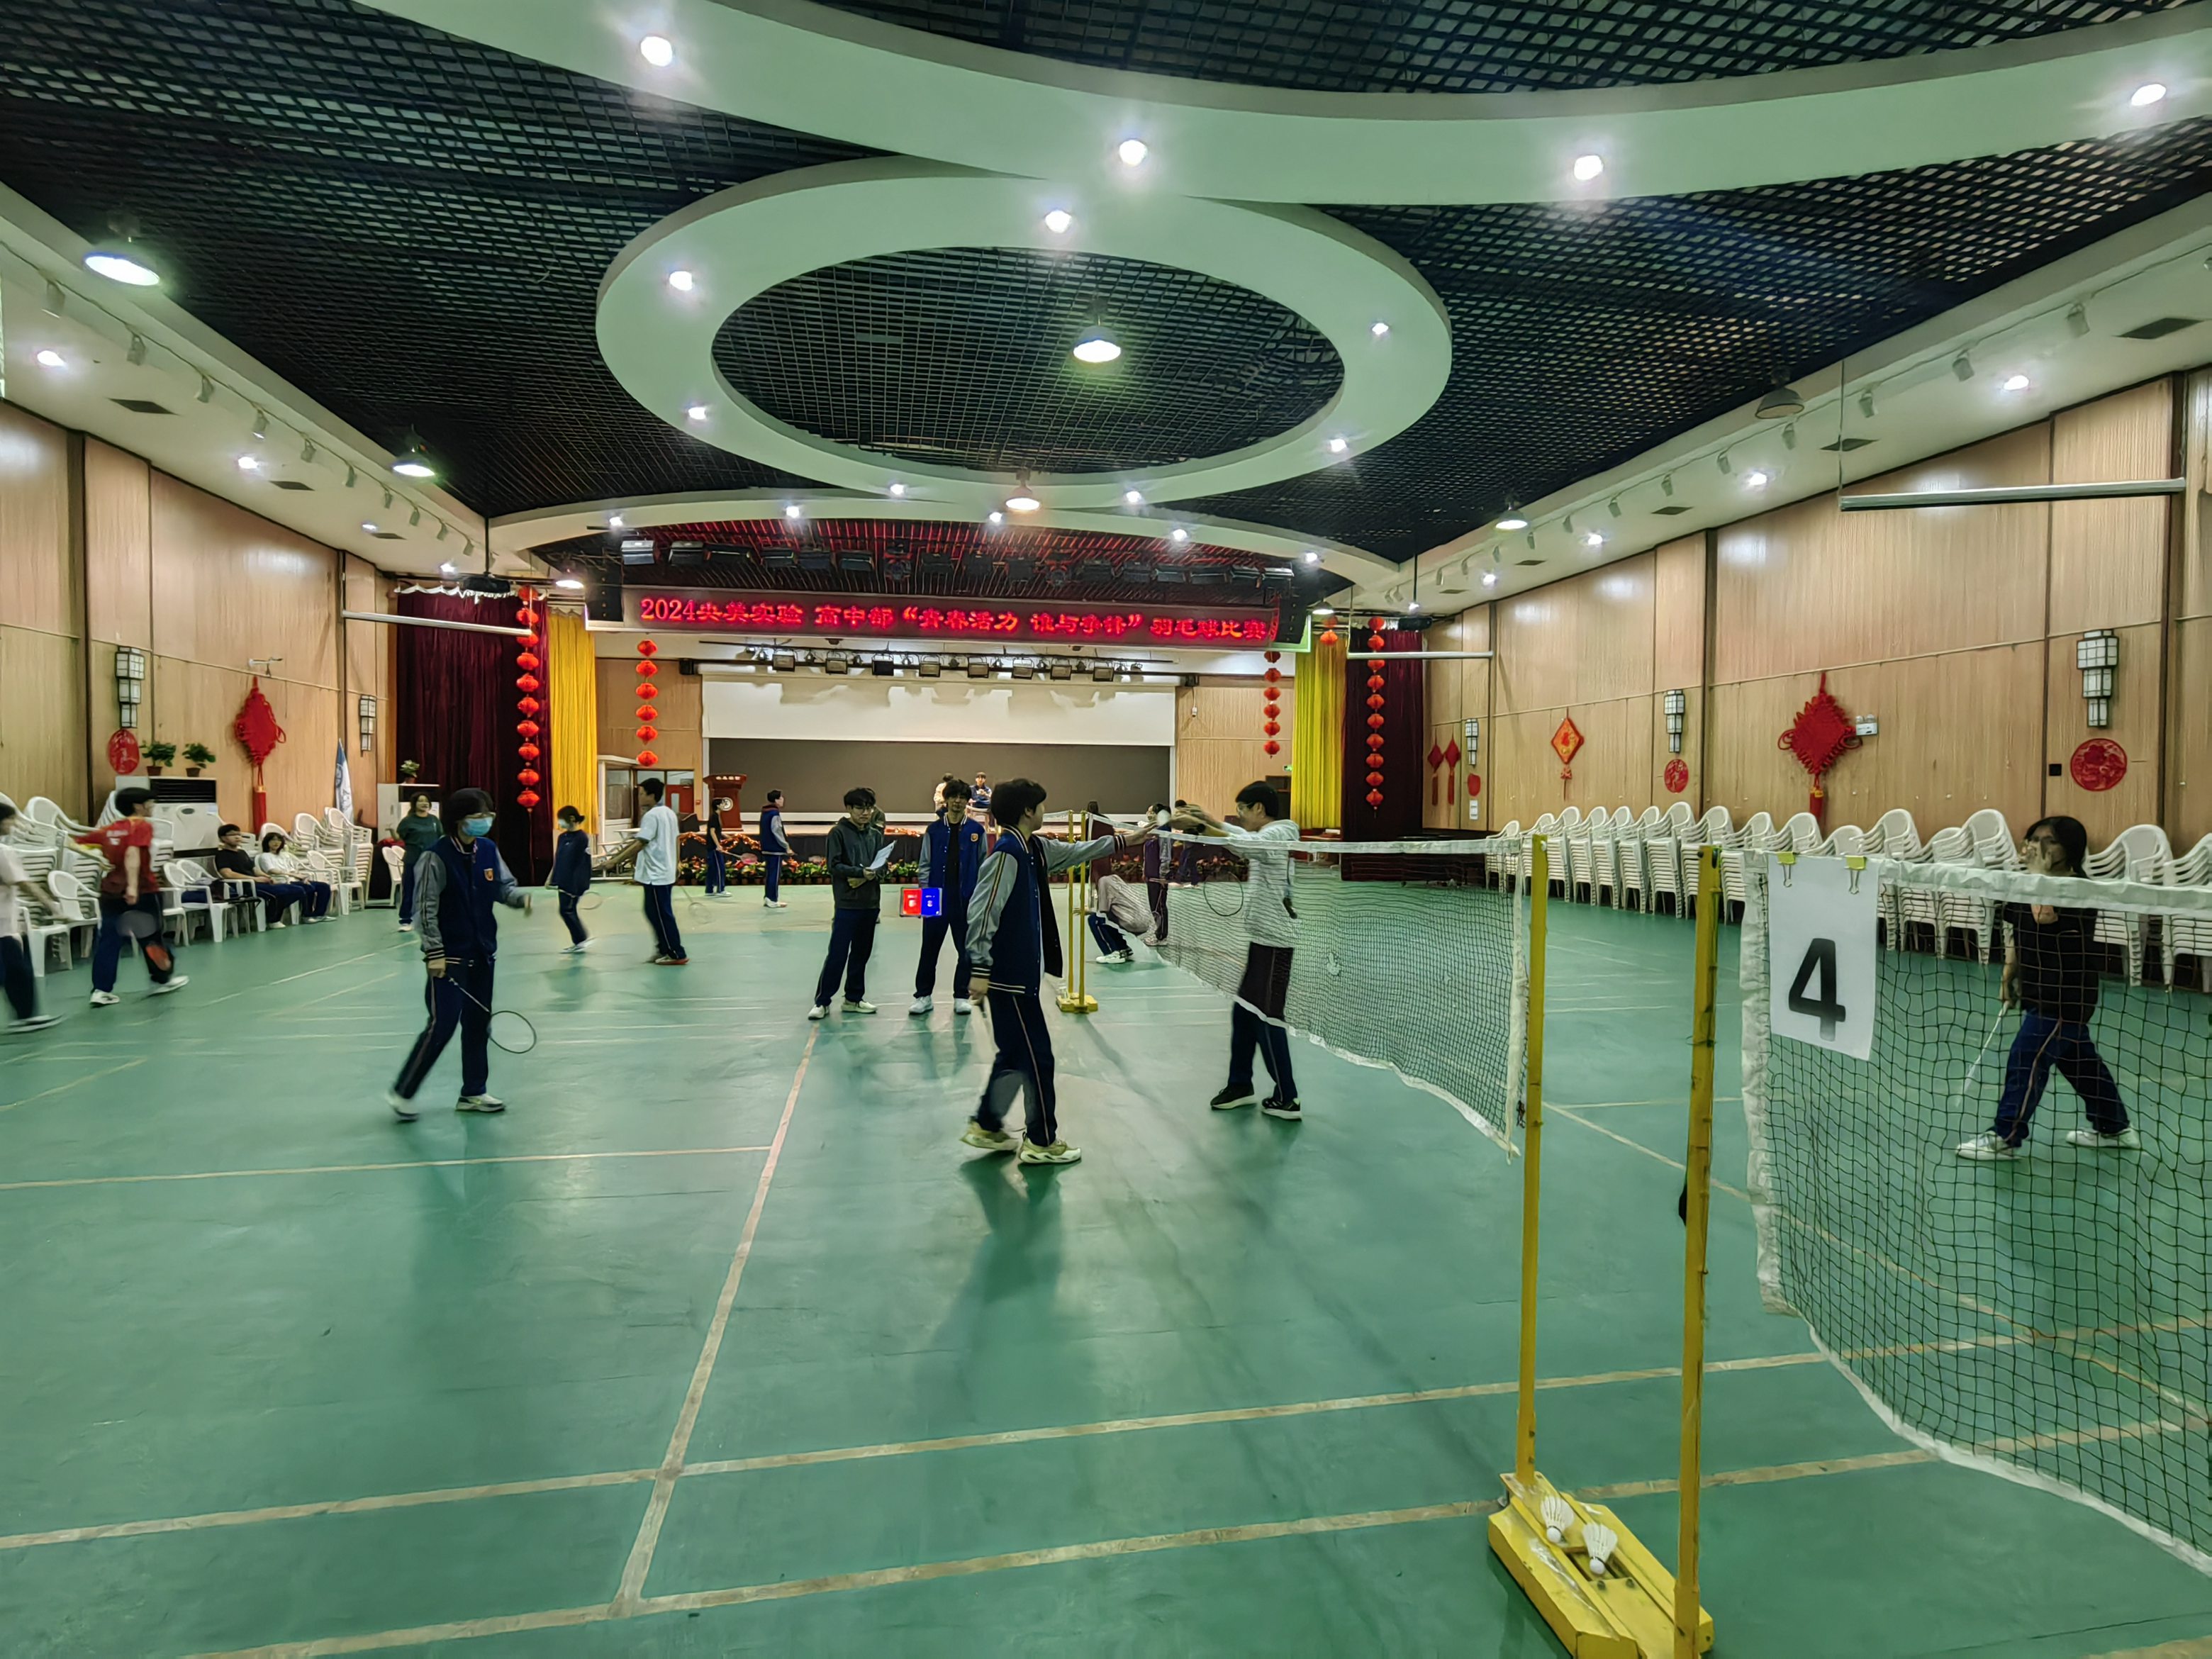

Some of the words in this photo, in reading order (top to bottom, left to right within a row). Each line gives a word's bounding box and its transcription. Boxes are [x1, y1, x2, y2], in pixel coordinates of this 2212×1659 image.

[815, 605, 893, 629] 高中部
[1151, 618, 1267, 639] 羽毛球比赛
[1788, 938, 1845, 1041] 4
